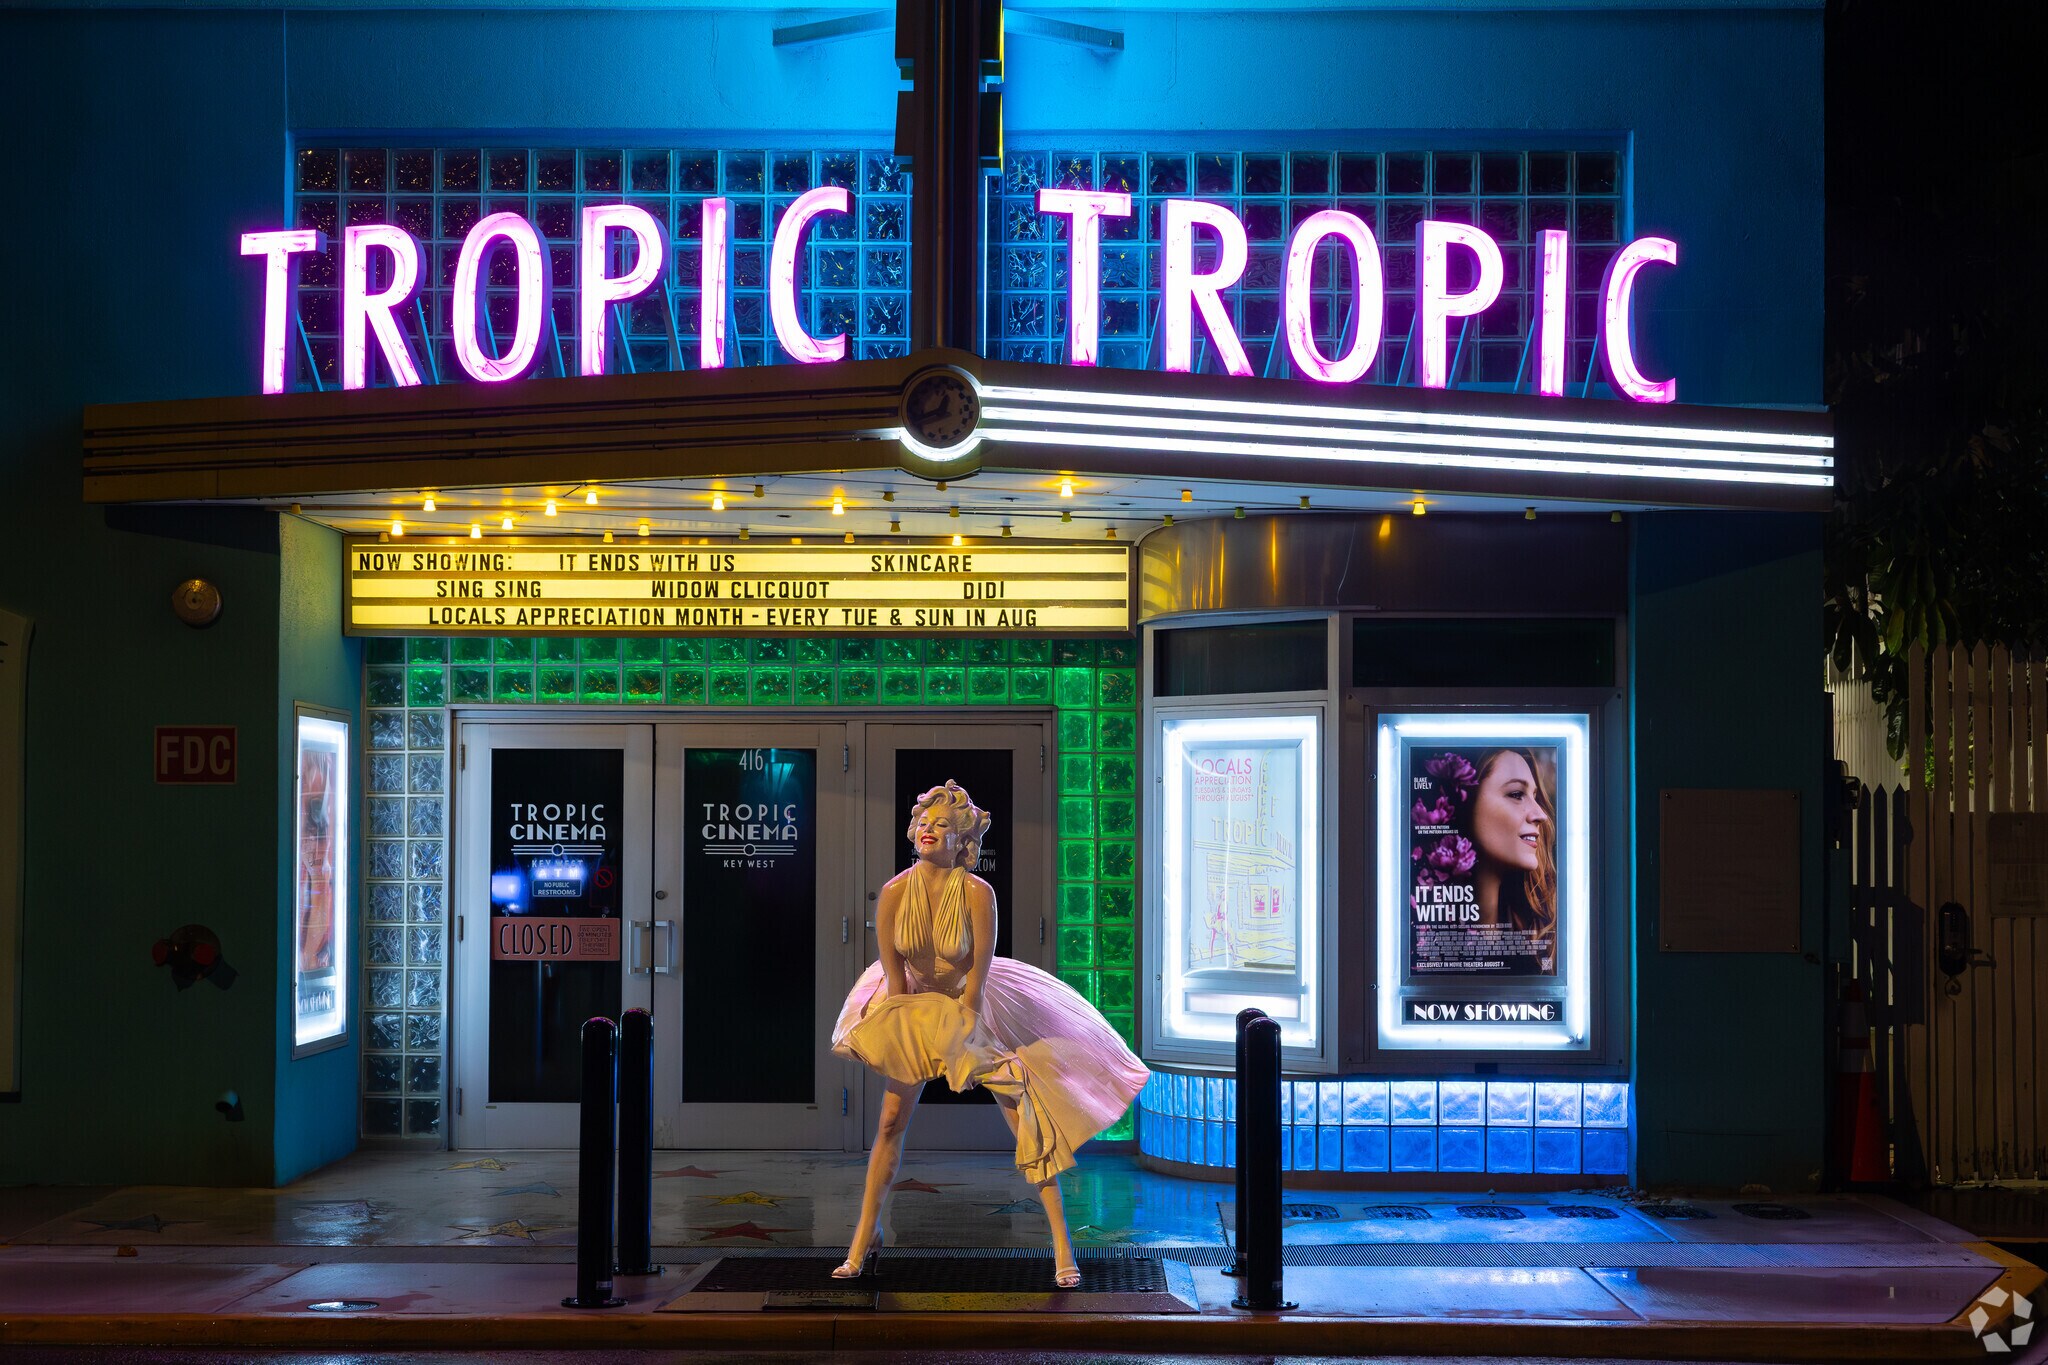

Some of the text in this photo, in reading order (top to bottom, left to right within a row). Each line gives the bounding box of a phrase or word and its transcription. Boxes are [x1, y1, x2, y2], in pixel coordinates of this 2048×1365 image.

[240, 187, 850, 395] TROPIC
[1034, 188, 1678, 404] TROPIC
[359, 553, 514, 572] NOW SHOWING:
[559, 553, 735, 572] IT ENDS WITH US
[870, 553, 973, 573] SKINCARE
[436, 580, 542, 599] SING SING
[651, 580, 830, 600] WIDOW CLICQUOT
[963, 580, 1005, 600] DIDI
[428, 606, 506, 626] LOCALS
[515, 606, 665, 626] APPRECIATION
[675, 607, 743, 626] MONTH
[767, 607, 830, 627] EVERY
[841, 607, 878, 627] TUE
[889, 608, 903, 627] &
[914, 607, 955, 627] SUN
[966, 607, 985, 627] IN
[997, 607, 1038, 627] AUG
[159, 735, 232, 776] FDC
[738, 748, 764, 771] 416
[1195, 758, 1253, 775] LOCALS
[1195, 775, 1252, 785] APPRECIATION
[1413, 782, 1433, 790] LIVELY
[1194, 786, 1221, 794] TUESDAYS
[1194, 794, 1225, 802] THROUGH
[510, 803, 605, 821] TROPIC
[702, 803, 797, 821] TROPIC
[509, 823, 607, 841] CINEMA
[701, 823, 798, 841] CINEMA
[531, 859, 584, 868] KEY WEST
[723, 859, 776, 868] KEY WEST
[538, 868, 579, 879] ATM
[1415, 884, 1474, 903] IT ENDS
[1416, 904, 1480, 922] WITH US
[499, 923, 573, 956] CLOSED
[1413, 1003, 1556, 1021] NOW SHOWING
